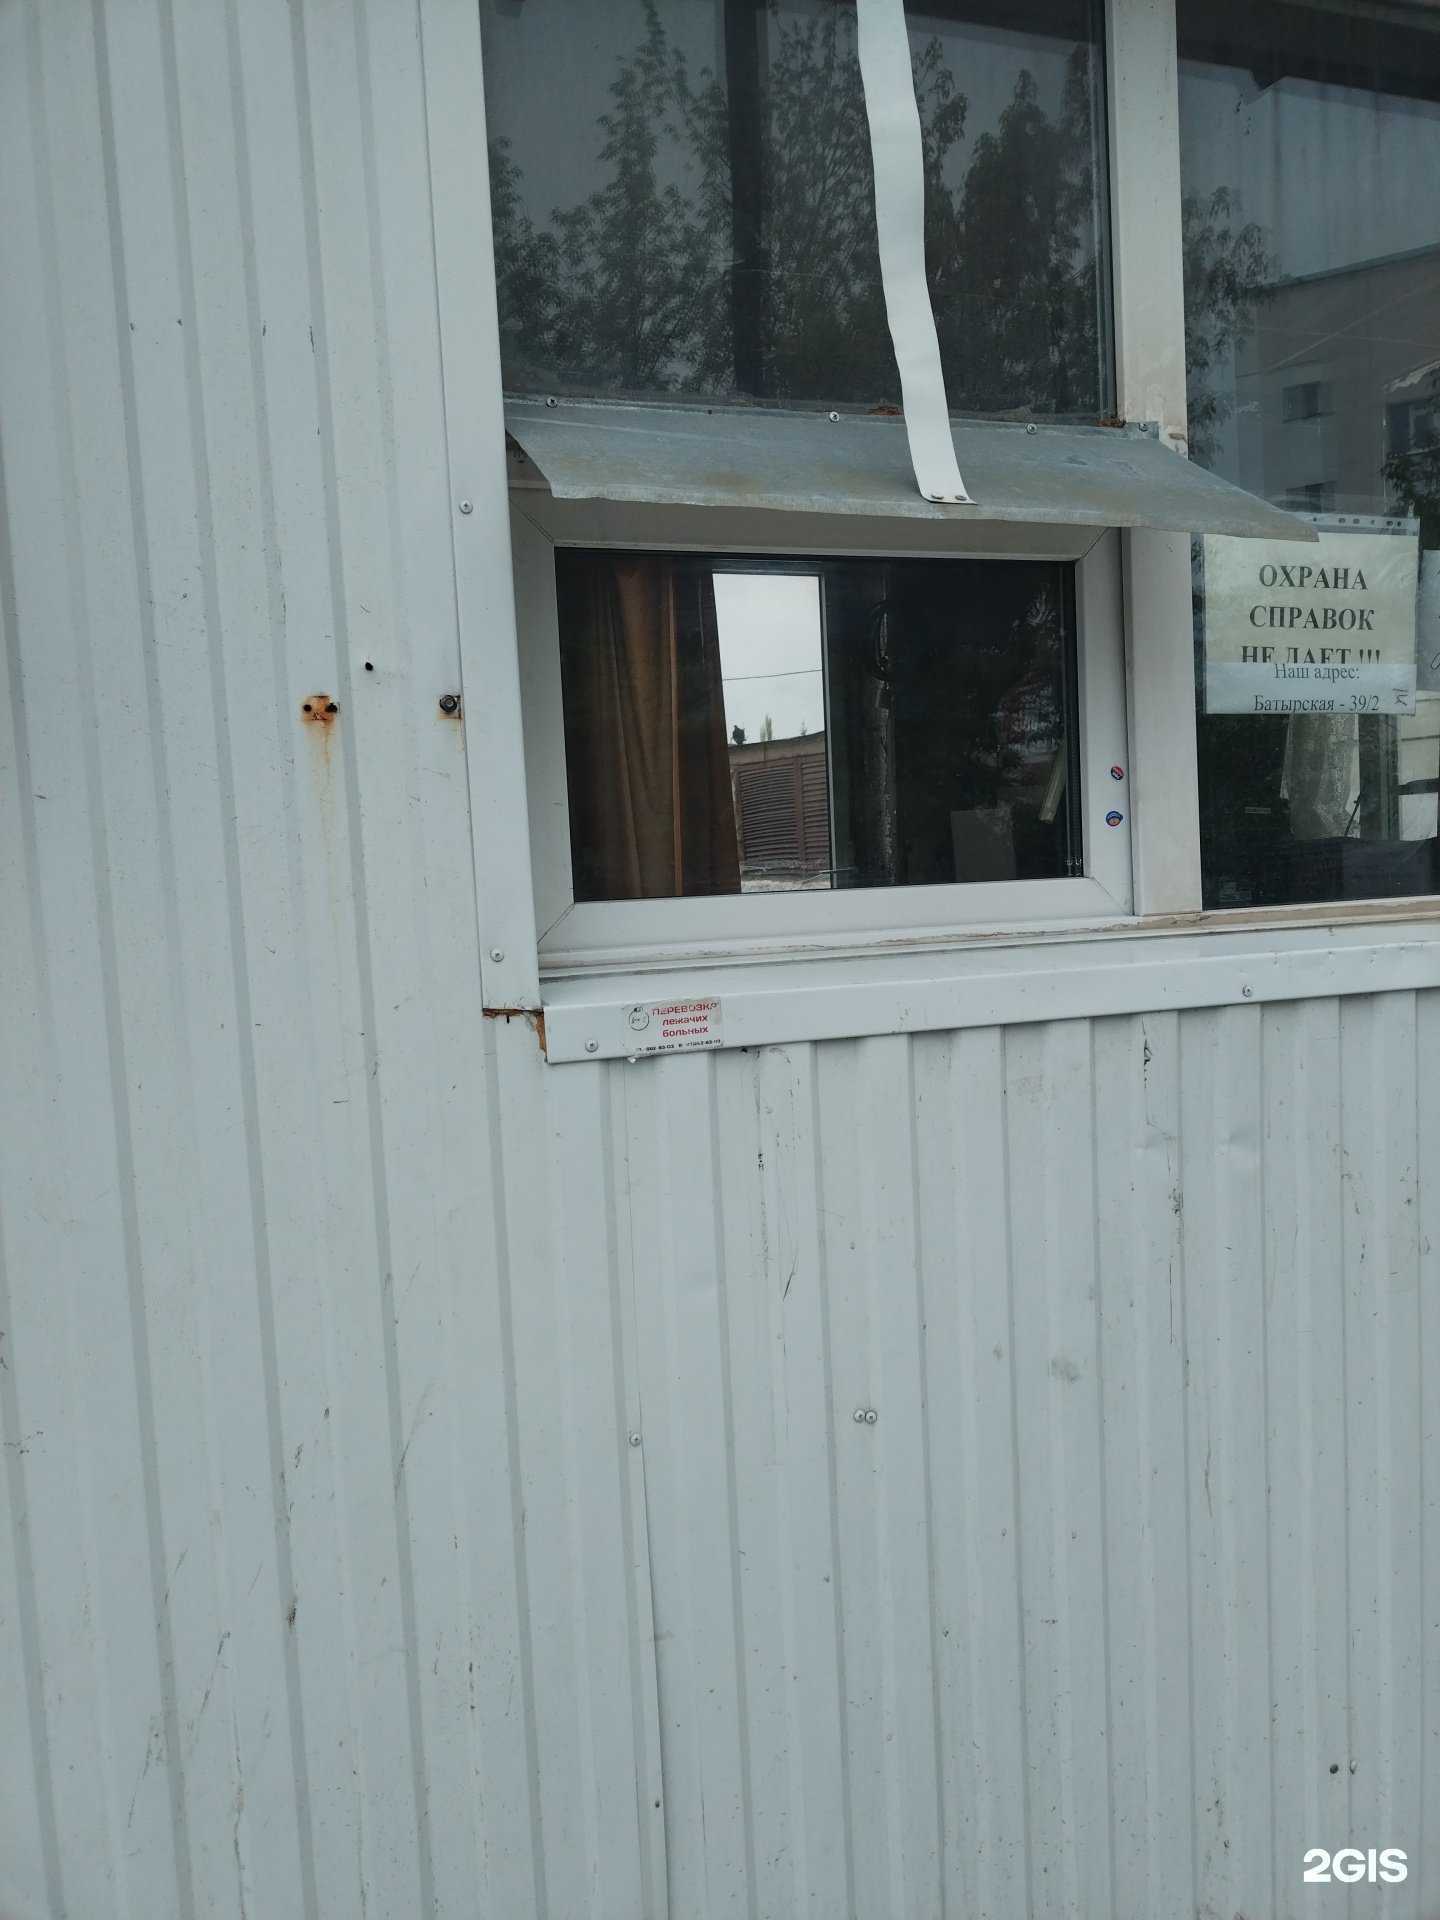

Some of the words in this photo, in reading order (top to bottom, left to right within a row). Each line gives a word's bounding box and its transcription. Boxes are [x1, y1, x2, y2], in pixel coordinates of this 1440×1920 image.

[1259, 564, 1368, 590] ОХРАНА
[1249, 605, 1375, 631] СПРАВОК
[1274, 664, 1309, 680] Наш
[1314, 666, 1360, 683] адрес:
[1253, 694, 1335, 713] Батырская
[1350, 696, 1380, 712] 39/2
[662, 1015, 708, 1027] лежачих
[662, 1026, 709, 1038] больных
